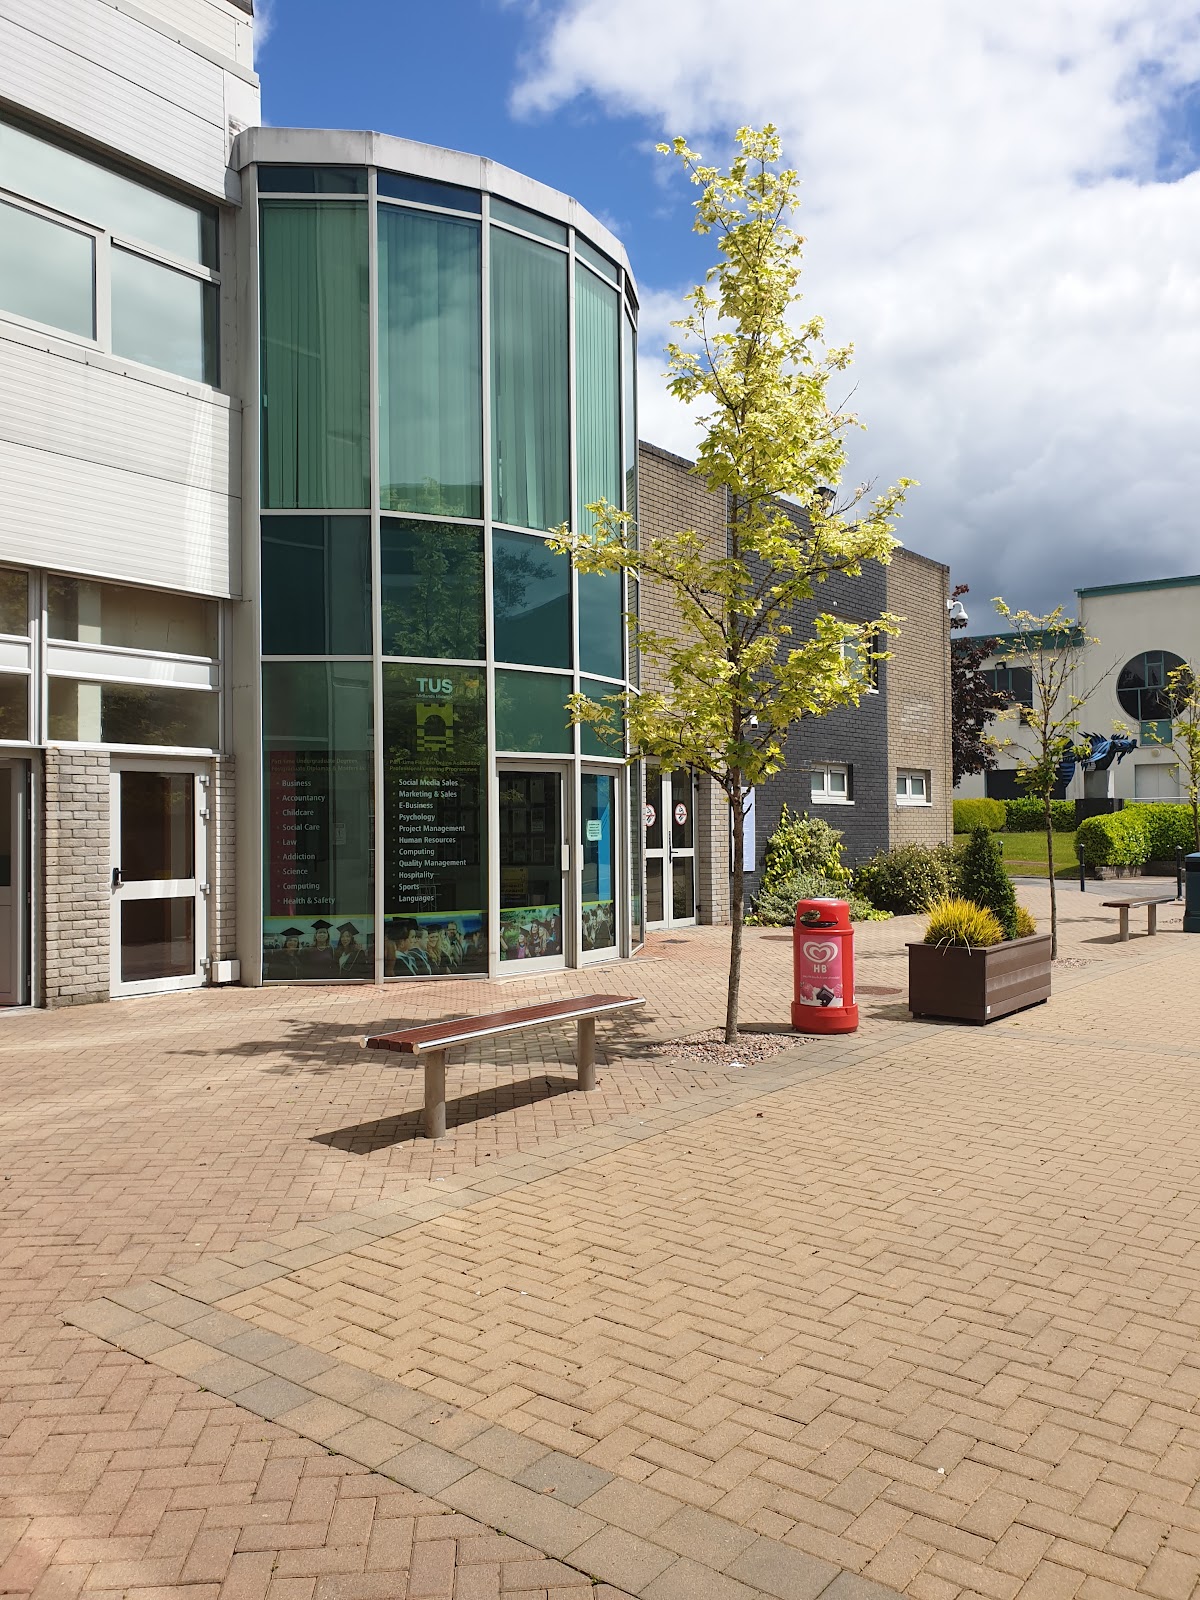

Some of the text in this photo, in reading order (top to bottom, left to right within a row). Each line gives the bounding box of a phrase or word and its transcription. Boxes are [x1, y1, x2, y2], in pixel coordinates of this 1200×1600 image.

[416, 678, 453, 693] TUS
[441, 779, 459, 787] Sales
[398, 790, 433, 799] Marketing
[434, 790, 439, 798] &
[398, 813, 435, 822] Psychology
[398, 825, 466, 834] Project Management
[398, 836, 456, 844] Human Resources
[398, 848, 435, 856] Computing
[398, 859, 467, 868] Quality Management
[398, 871, 434, 879] Hospitality
[398, 883, 420, 892] Sports
[283, 897, 306, 905] Health
[313, 896, 336, 904] Safety
[398, 895, 435, 903] Languages
[813, 964, 827, 973] HB
